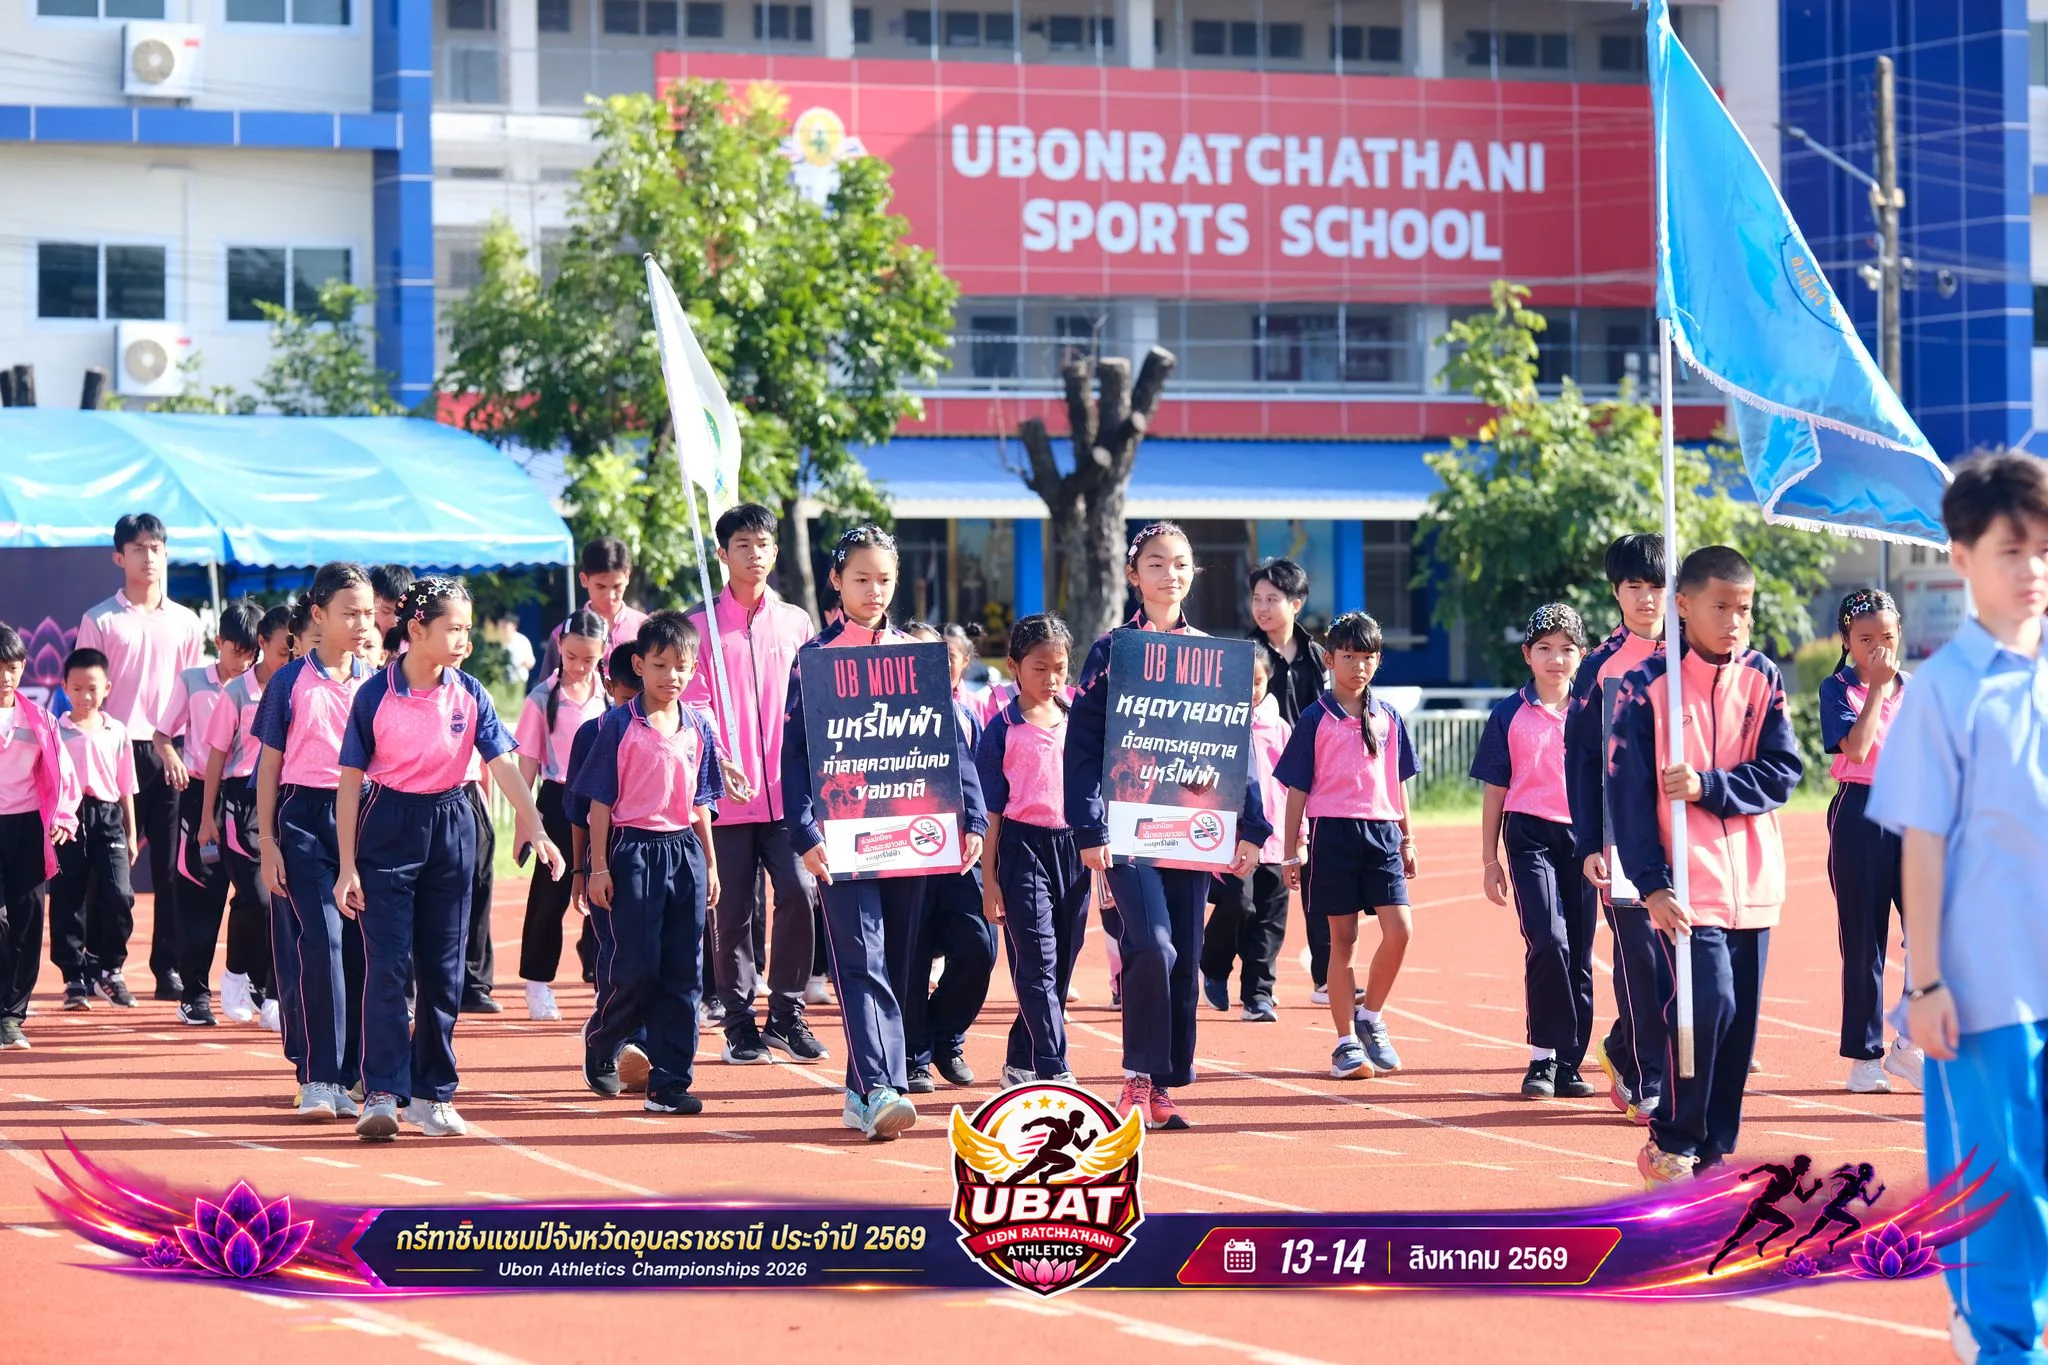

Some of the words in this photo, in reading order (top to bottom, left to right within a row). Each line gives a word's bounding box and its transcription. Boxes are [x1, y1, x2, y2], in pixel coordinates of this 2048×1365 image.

[951, 123, 1546, 193] UBONRATCHATHANI
[1021, 197, 1250, 256] SPORTS
[1280, 204, 1504, 261] SCHOOL
[834, 659, 860, 699] UB
[867, 655, 919, 697] MOVE
[1143, 642, 1167, 682] UB
[1175, 645, 1224, 688] MOVE
[1115, 693, 1250, 728] หยุดขายชาติ
[823, 746, 950, 775] ทำลายความมั่นคง
[1121, 729, 1238, 763] ด้วยการหยุดขาย
[856, 778, 926, 800] ของชาติ
